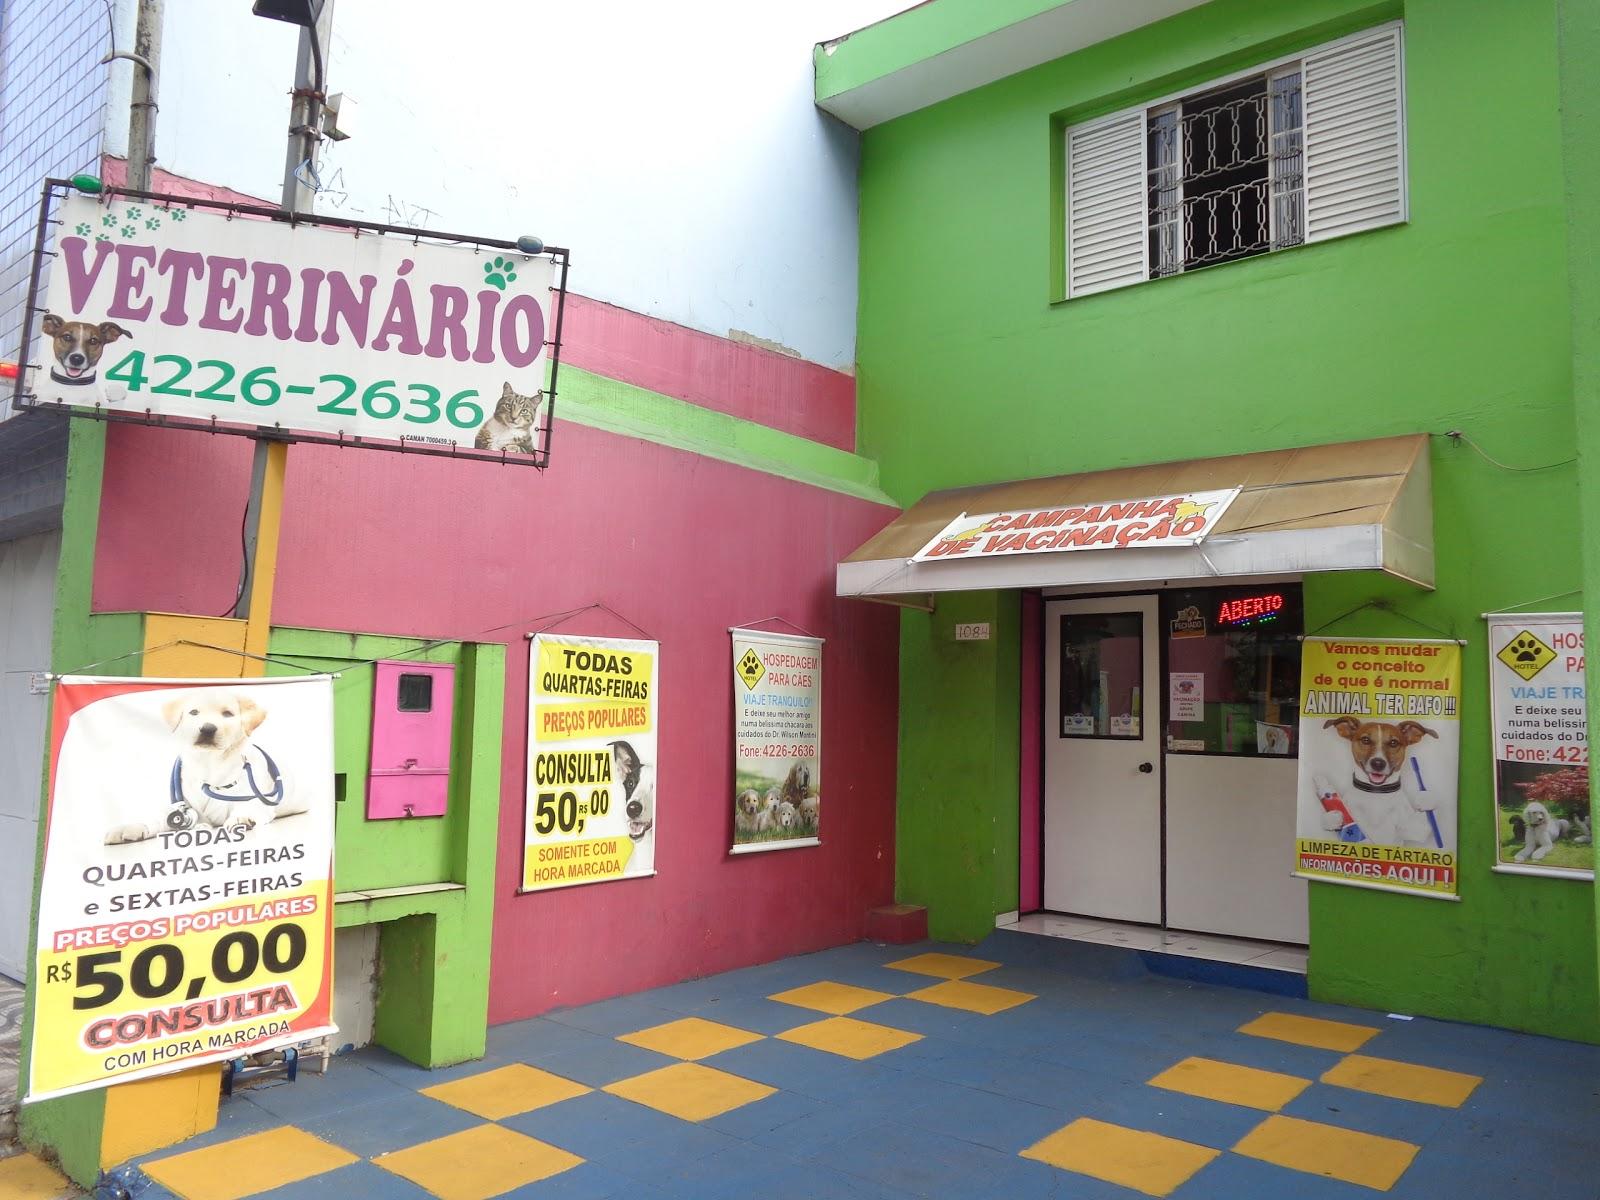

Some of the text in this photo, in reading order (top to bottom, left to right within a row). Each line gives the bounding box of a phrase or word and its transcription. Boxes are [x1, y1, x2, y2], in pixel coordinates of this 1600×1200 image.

[60, 236, 545, 369] VETERINÁRIO
[105, 350, 485, 430] 4226-2636
[981, 497, 1185, 533] CAMPANHA
[925, 516, 1207, 557] DE VACINAÇÃO
[1218, 594, 1282, 623] ABERTO
[1324, 642, 1441, 657] Vamos mudar
[563, 650, 632, 675] TODAS
[763, 652, 818, 670] HOSPEDAGEM
[1336, 660, 1425, 673] o conceito
[1514, 663, 1539, 671] HOTEL
[543, 672, 647, 699] QUARTAS-FEIRAS
[768, 671, 812, 688] PARA CÃES
[1314, 674, 1449, 691] de que é normal
[743, 693, 766, 706] VIAJE
[1304, 690, 1371, 714] ANIMAL
[1375, 693, 1405, 715] TER
[1511, 686, 1586, 700] VIAJE TR
[544, 707, 646, 736] PREÇOS POPULARES
[744, 708, 749, 717] E
[750, 708, 765, 718] deixe
[777, 710, 795, 719] melhor
[796, 711, 811, 721] amigo
[1515, 705, 1582, 716] E deixe seu
[738, 730, 763, 739] cuidados
[764, 730, 772, 738] do
[781, 730, 799, 739] Wilson
[740, 720, 758, 728] numa
[1508, 719, 1540, 728] numa
[1501, 730, 1554, 741] cuidados
[1557, 731, 1573, 741] do
[740, 744, 815, 758] Fone: 4226-2636
[1505, 744, 1550, 762] Fone:
[535, 753, 611, 785] CONSULTA
[159, 825, 247, 850] TODAS
[538, 841, 617, 862] SOMENTE COM
[1301, 841, 1453, 866] LIMPEZA DE TÁRTARO
[82, 843, 305, 887] QUARTAS-FEIRAS
[534, 860, 621, 882] HORA MARCADA
[1300, 857, 1382, 878] INFORMAÇÕES
[84, 872, 303, 916] e SEXTAS-FEIRAS
[56, 896, 317, 950] PREÇOS POPULARES
[46, 923, 307, 1010] R$ 50,00
[85, 985, 297, 1048] CONSULTA
[104, 1020, 290, 1072] COM HORA MARCADA
